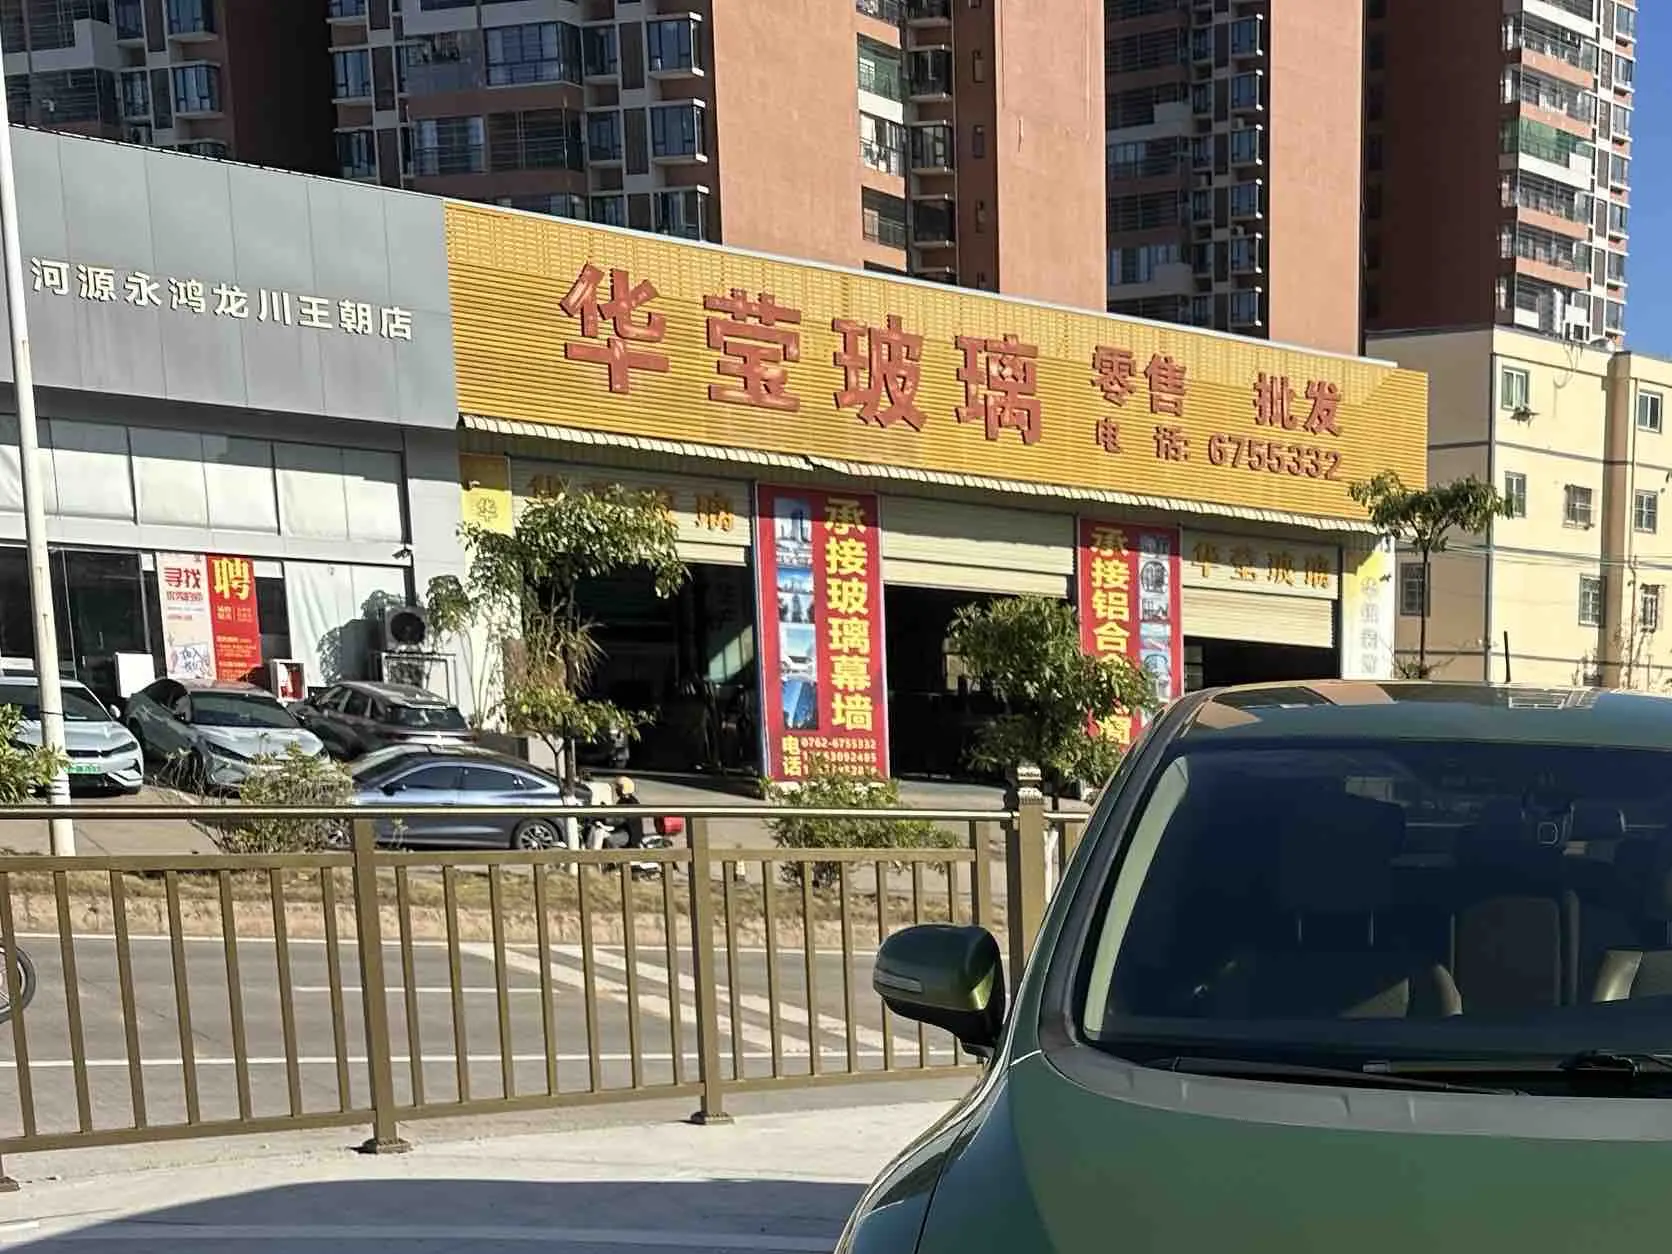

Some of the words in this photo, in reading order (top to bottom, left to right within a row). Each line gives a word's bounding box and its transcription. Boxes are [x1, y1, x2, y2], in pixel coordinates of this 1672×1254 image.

[30, 256, 414, 340] 河源永鸿龙川王朝店
[559, 261, 1043, 445] 华莹玻璃
[1091, 344, 1188, 417] 零售
[1252, 371, 1343, 437] 批发
[1207, 432, 1343, 482] 6755332
[164, 566, 202, 589] 寻找
[213, 556, 252, 600] 聘
[824, 496, 874, 732] 承接玻璃幕墙
[1090, 526, 1132, 746] 承接铝合窗
[782, 735, 801, 776] 电话
